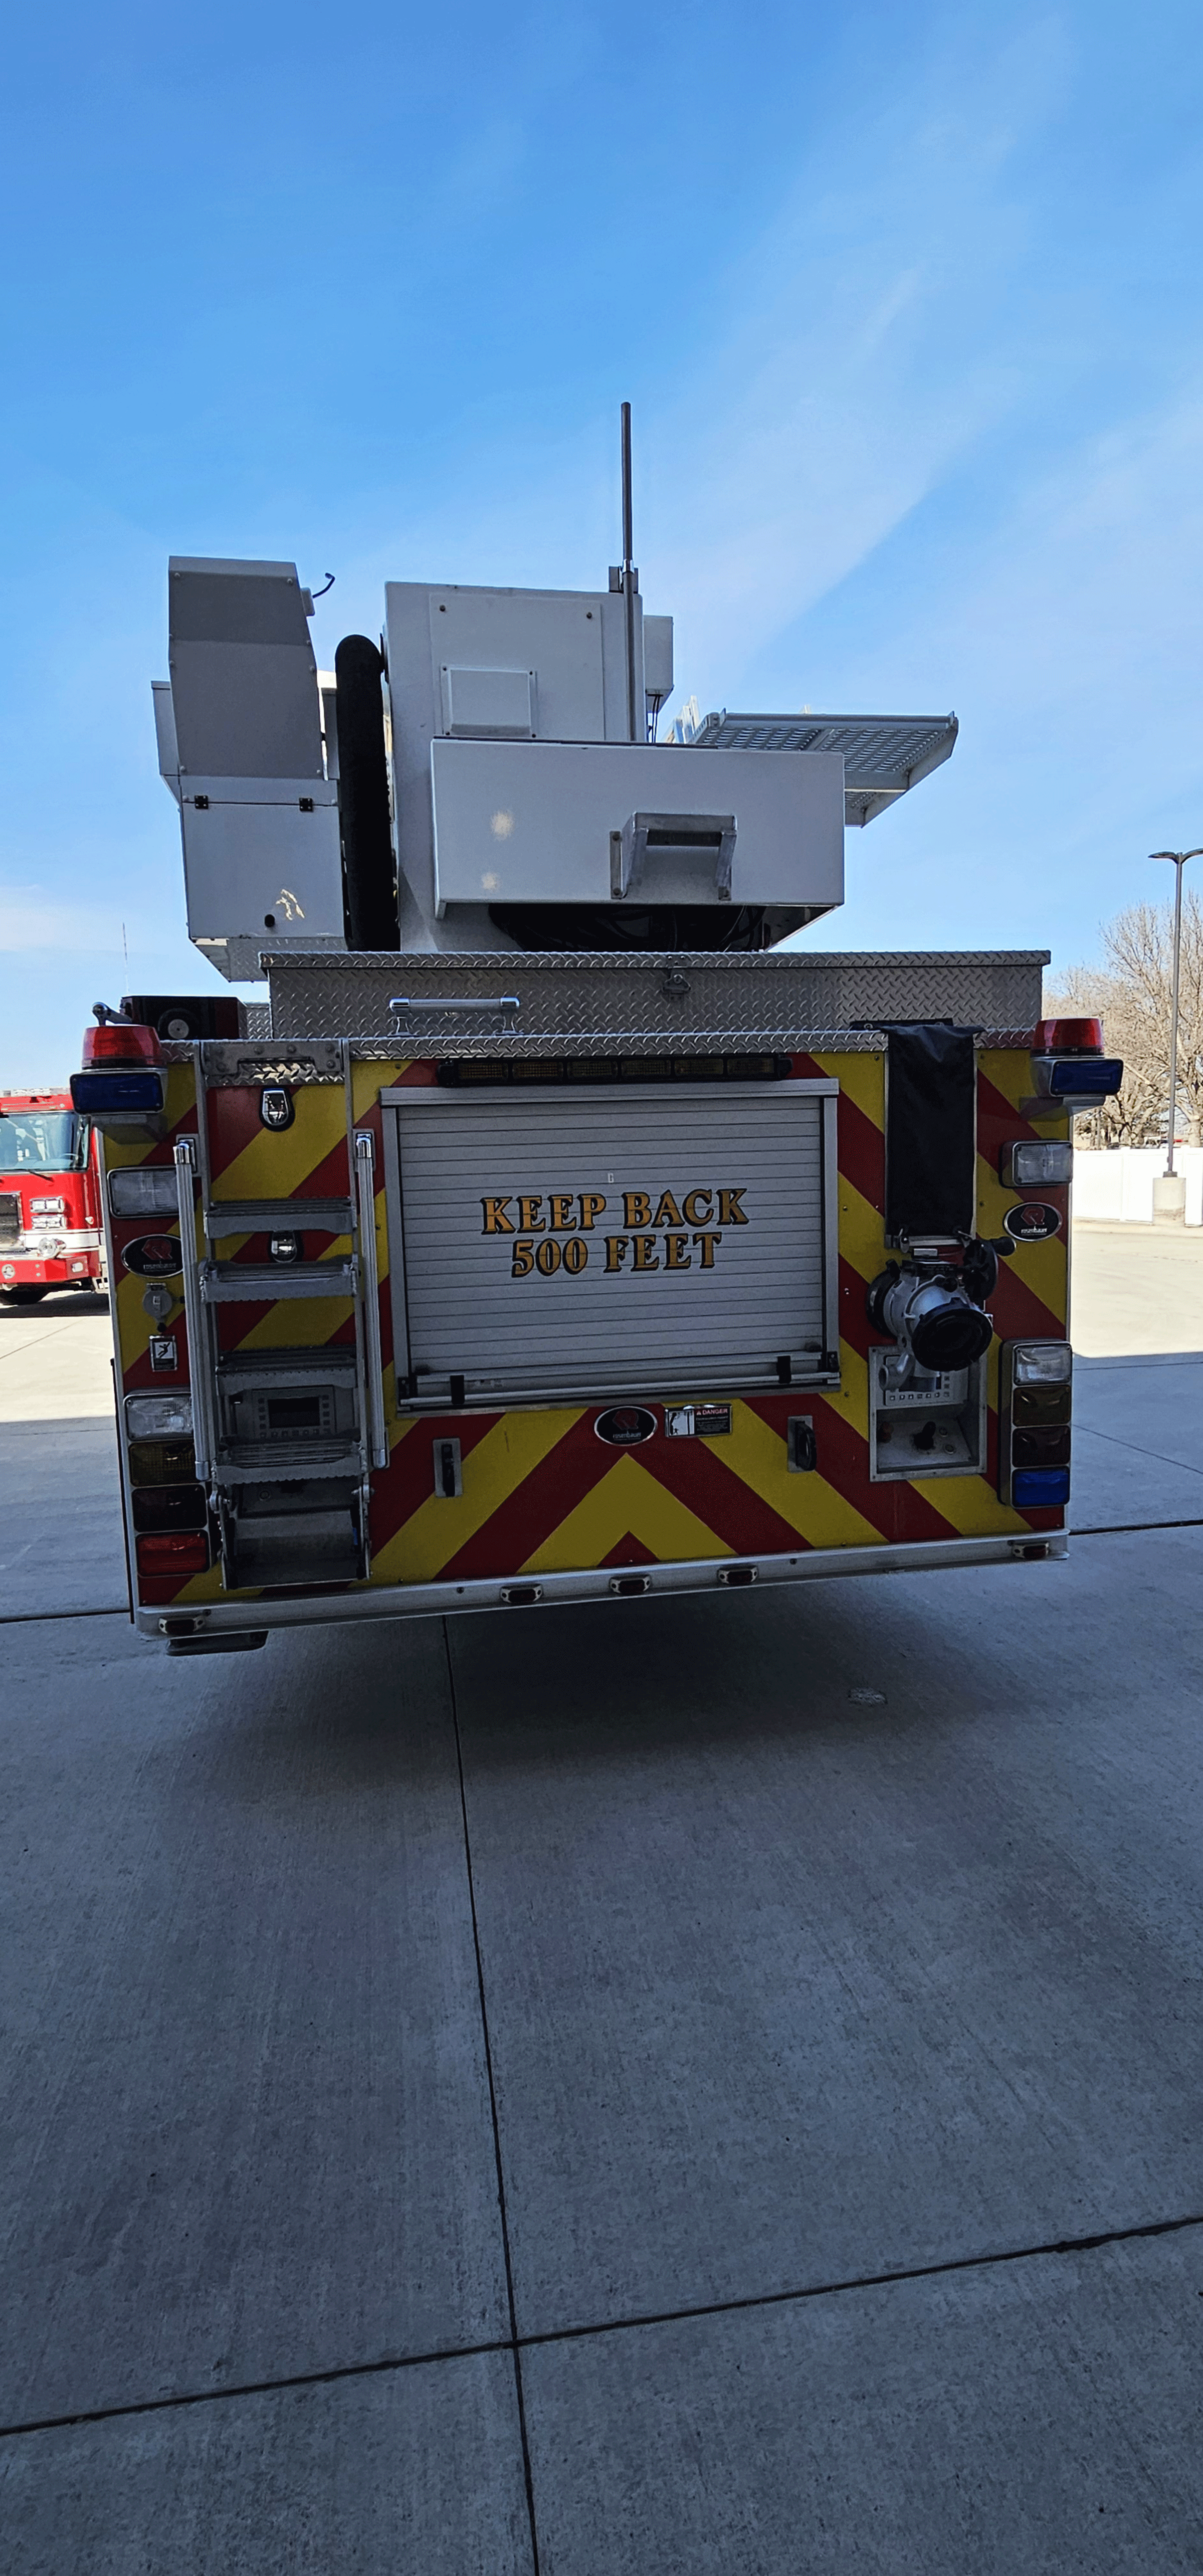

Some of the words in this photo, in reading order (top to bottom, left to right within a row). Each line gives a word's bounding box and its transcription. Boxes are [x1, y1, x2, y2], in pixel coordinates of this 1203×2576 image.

[481, 1194, 606, 1234] KEEP
[623, 1188, 749, 1228] BACK
[512, 1237, 588, 1277] 500
[604, 1232, 722, 1272] FEET
